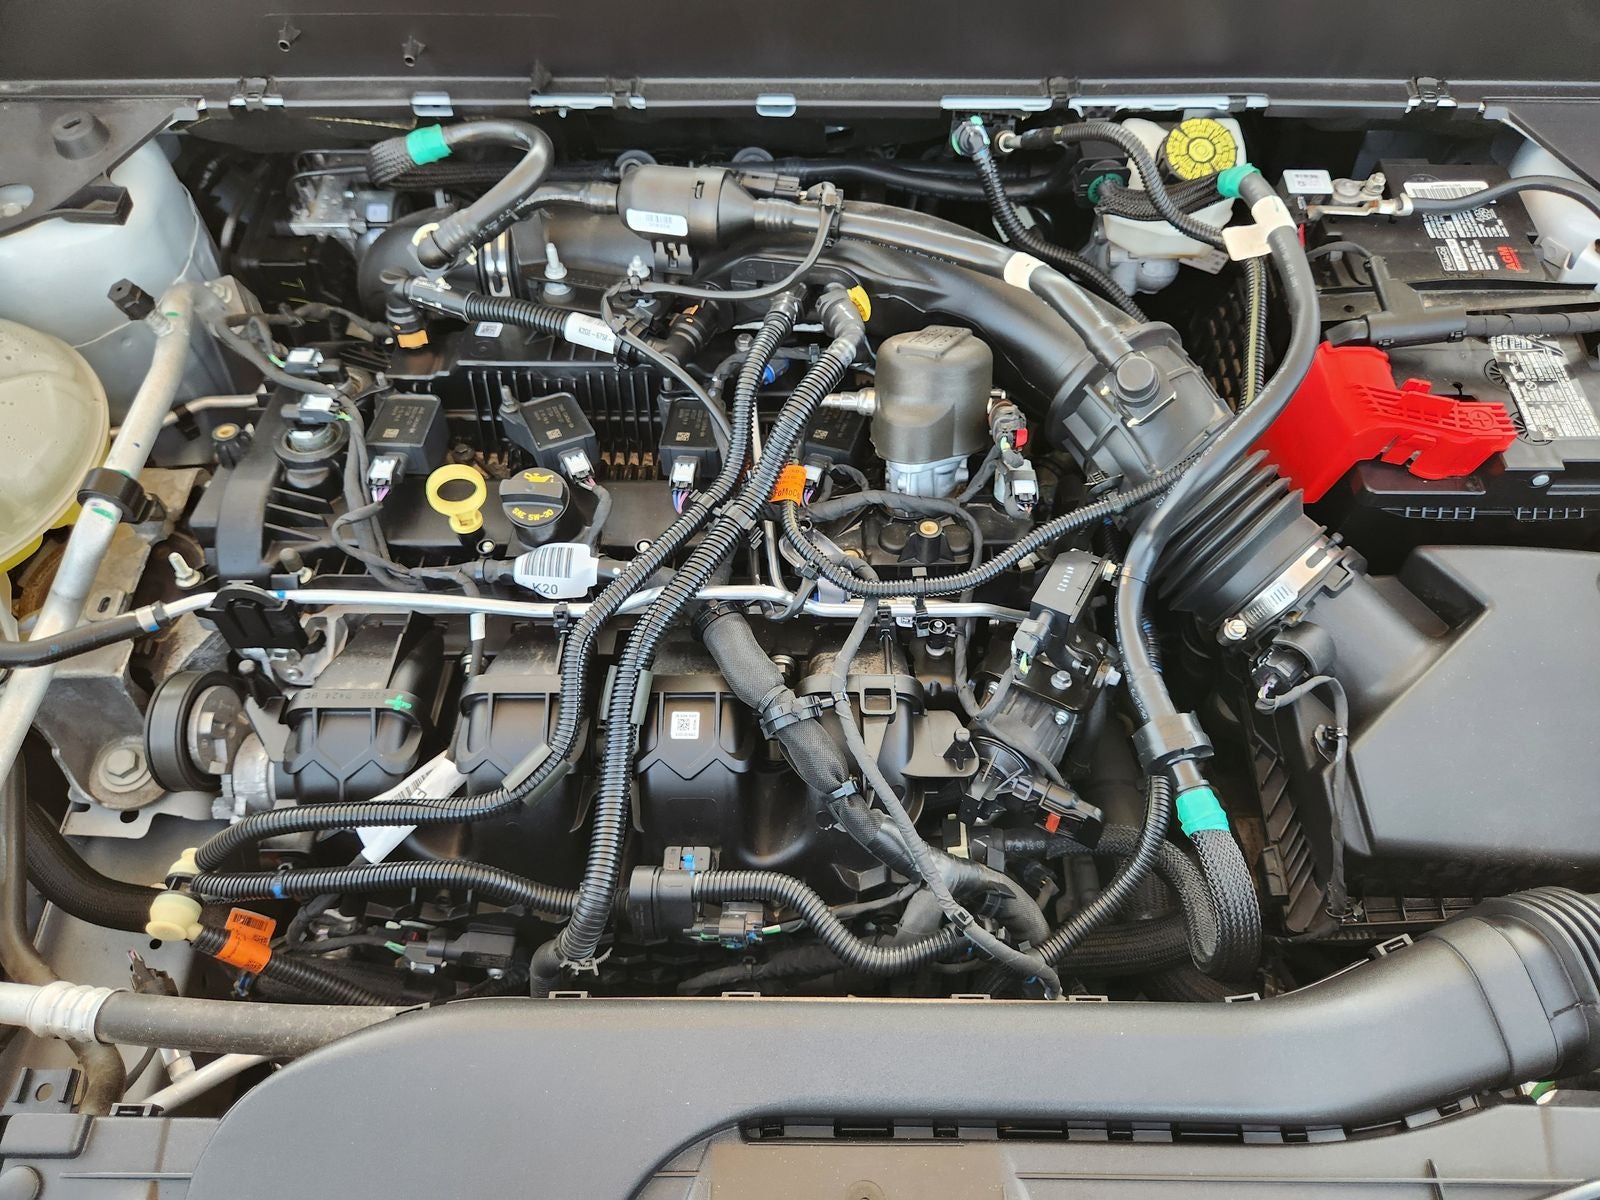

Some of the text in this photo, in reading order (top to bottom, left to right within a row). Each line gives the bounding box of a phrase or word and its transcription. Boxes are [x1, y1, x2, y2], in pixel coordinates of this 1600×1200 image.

[1497, 246, 1519, 270] AGM
[512, 507, 554, 520] SAE 5W-30
[532, 582, 558, 594] K20
